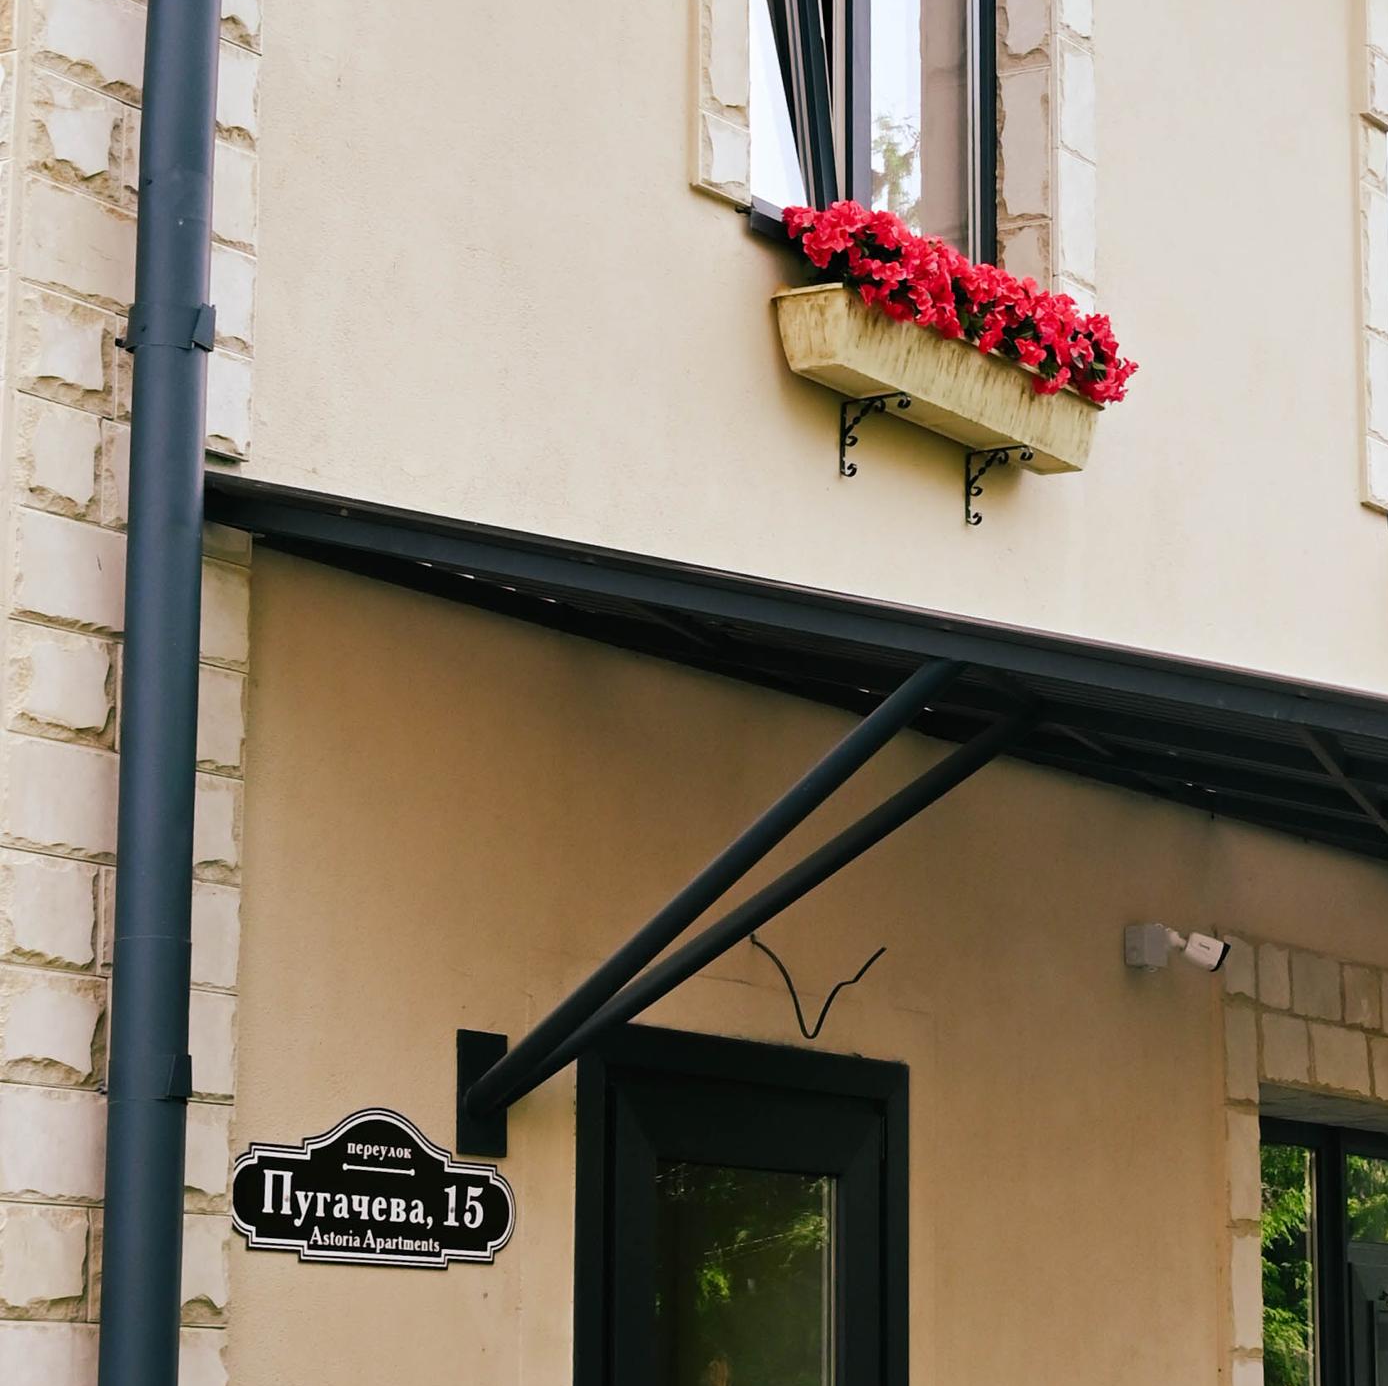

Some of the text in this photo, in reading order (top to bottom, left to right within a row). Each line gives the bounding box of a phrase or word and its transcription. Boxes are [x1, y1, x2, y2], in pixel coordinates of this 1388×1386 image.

[347, 1142, 412, 1160] переулок
[262, 1169, 484, 1229] Пугачева, 15
[309, 1226, 440, 1253] Astoria Apartments
